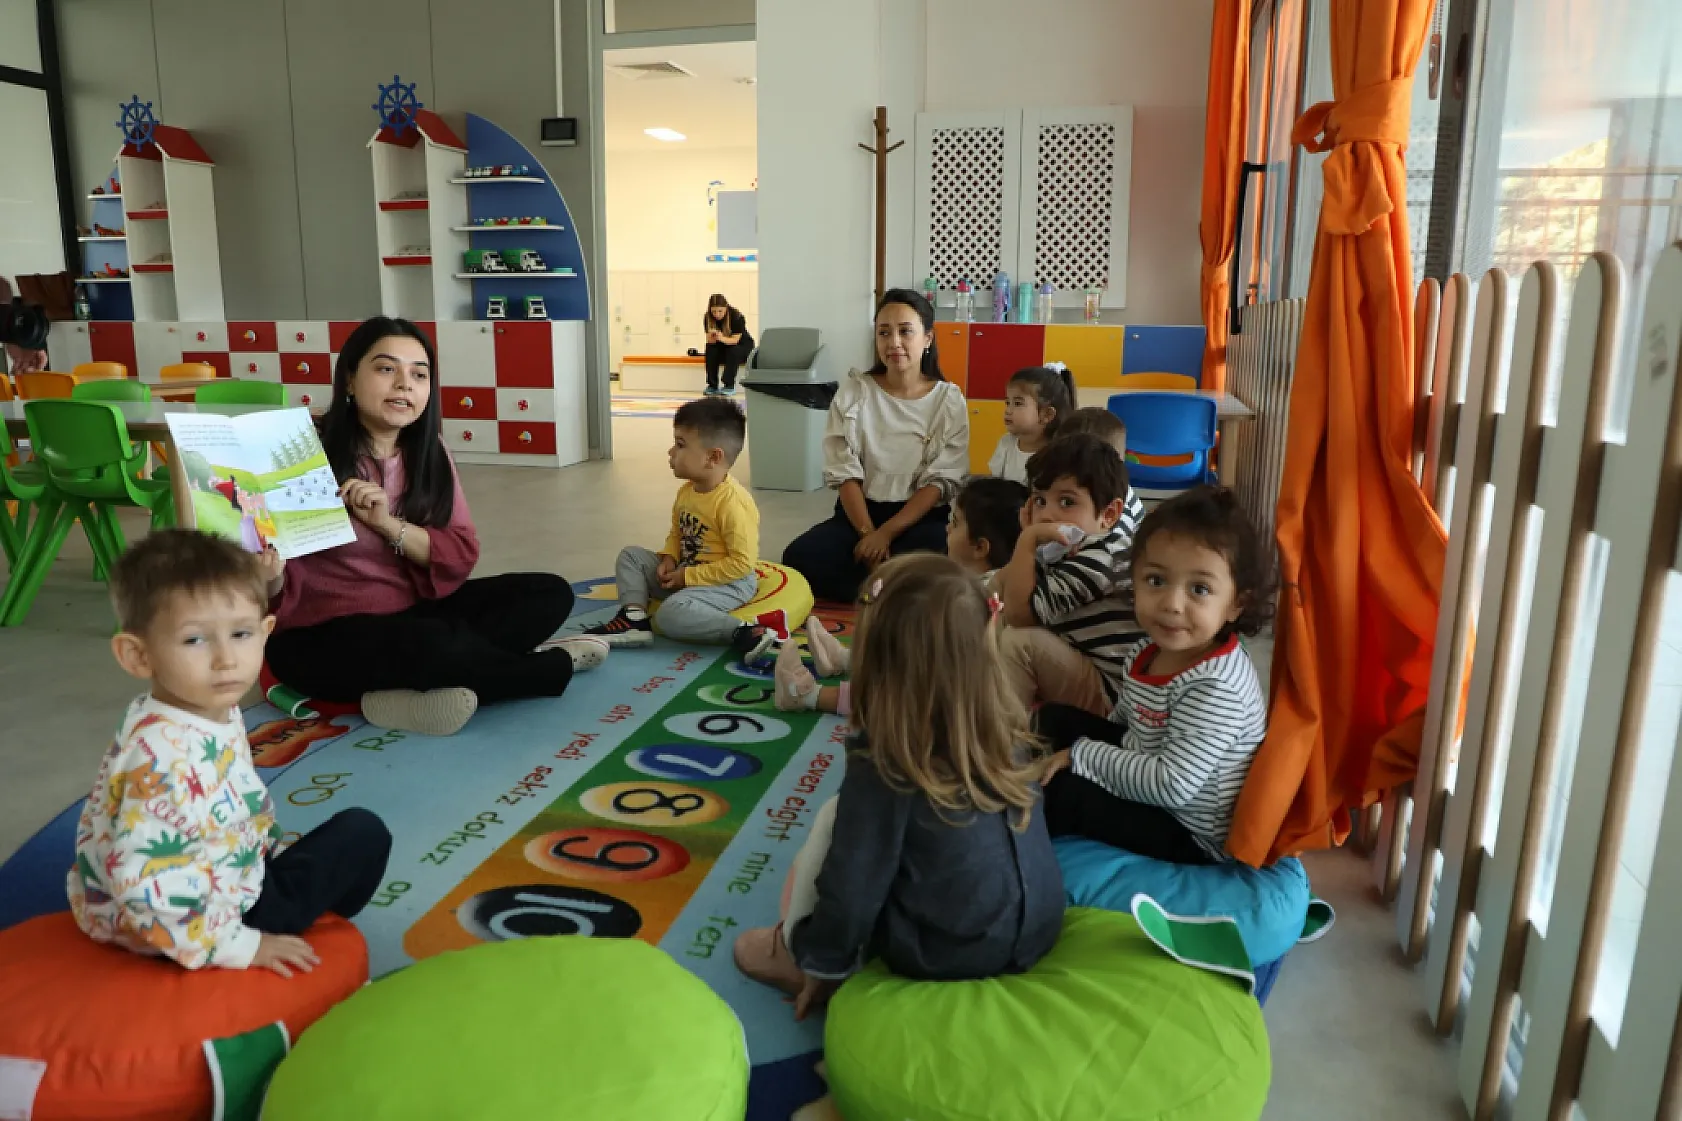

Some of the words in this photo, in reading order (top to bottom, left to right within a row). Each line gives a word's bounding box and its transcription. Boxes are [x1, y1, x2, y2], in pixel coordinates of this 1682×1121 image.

[698, 713, 764, 735] 6
[553, 732, 601, 760] yedi
[655, 753, 736, 777] 7
[793, 752, 834, 794] seven
[287, 772, 353, 806] Qq
[494, 766, 553, 806] sekiz
[612, 788, 704, 817] 8
[763, 794, 811, 842] eight
[418, 811, 504, 865] dokuz
[551, 836, 660, 871] 9
[727, 851, 775, 894] nine
[369, 881, 412, 907] on
[488, 892, 614, 938] 10
[686, 915, 739, 959] ten
